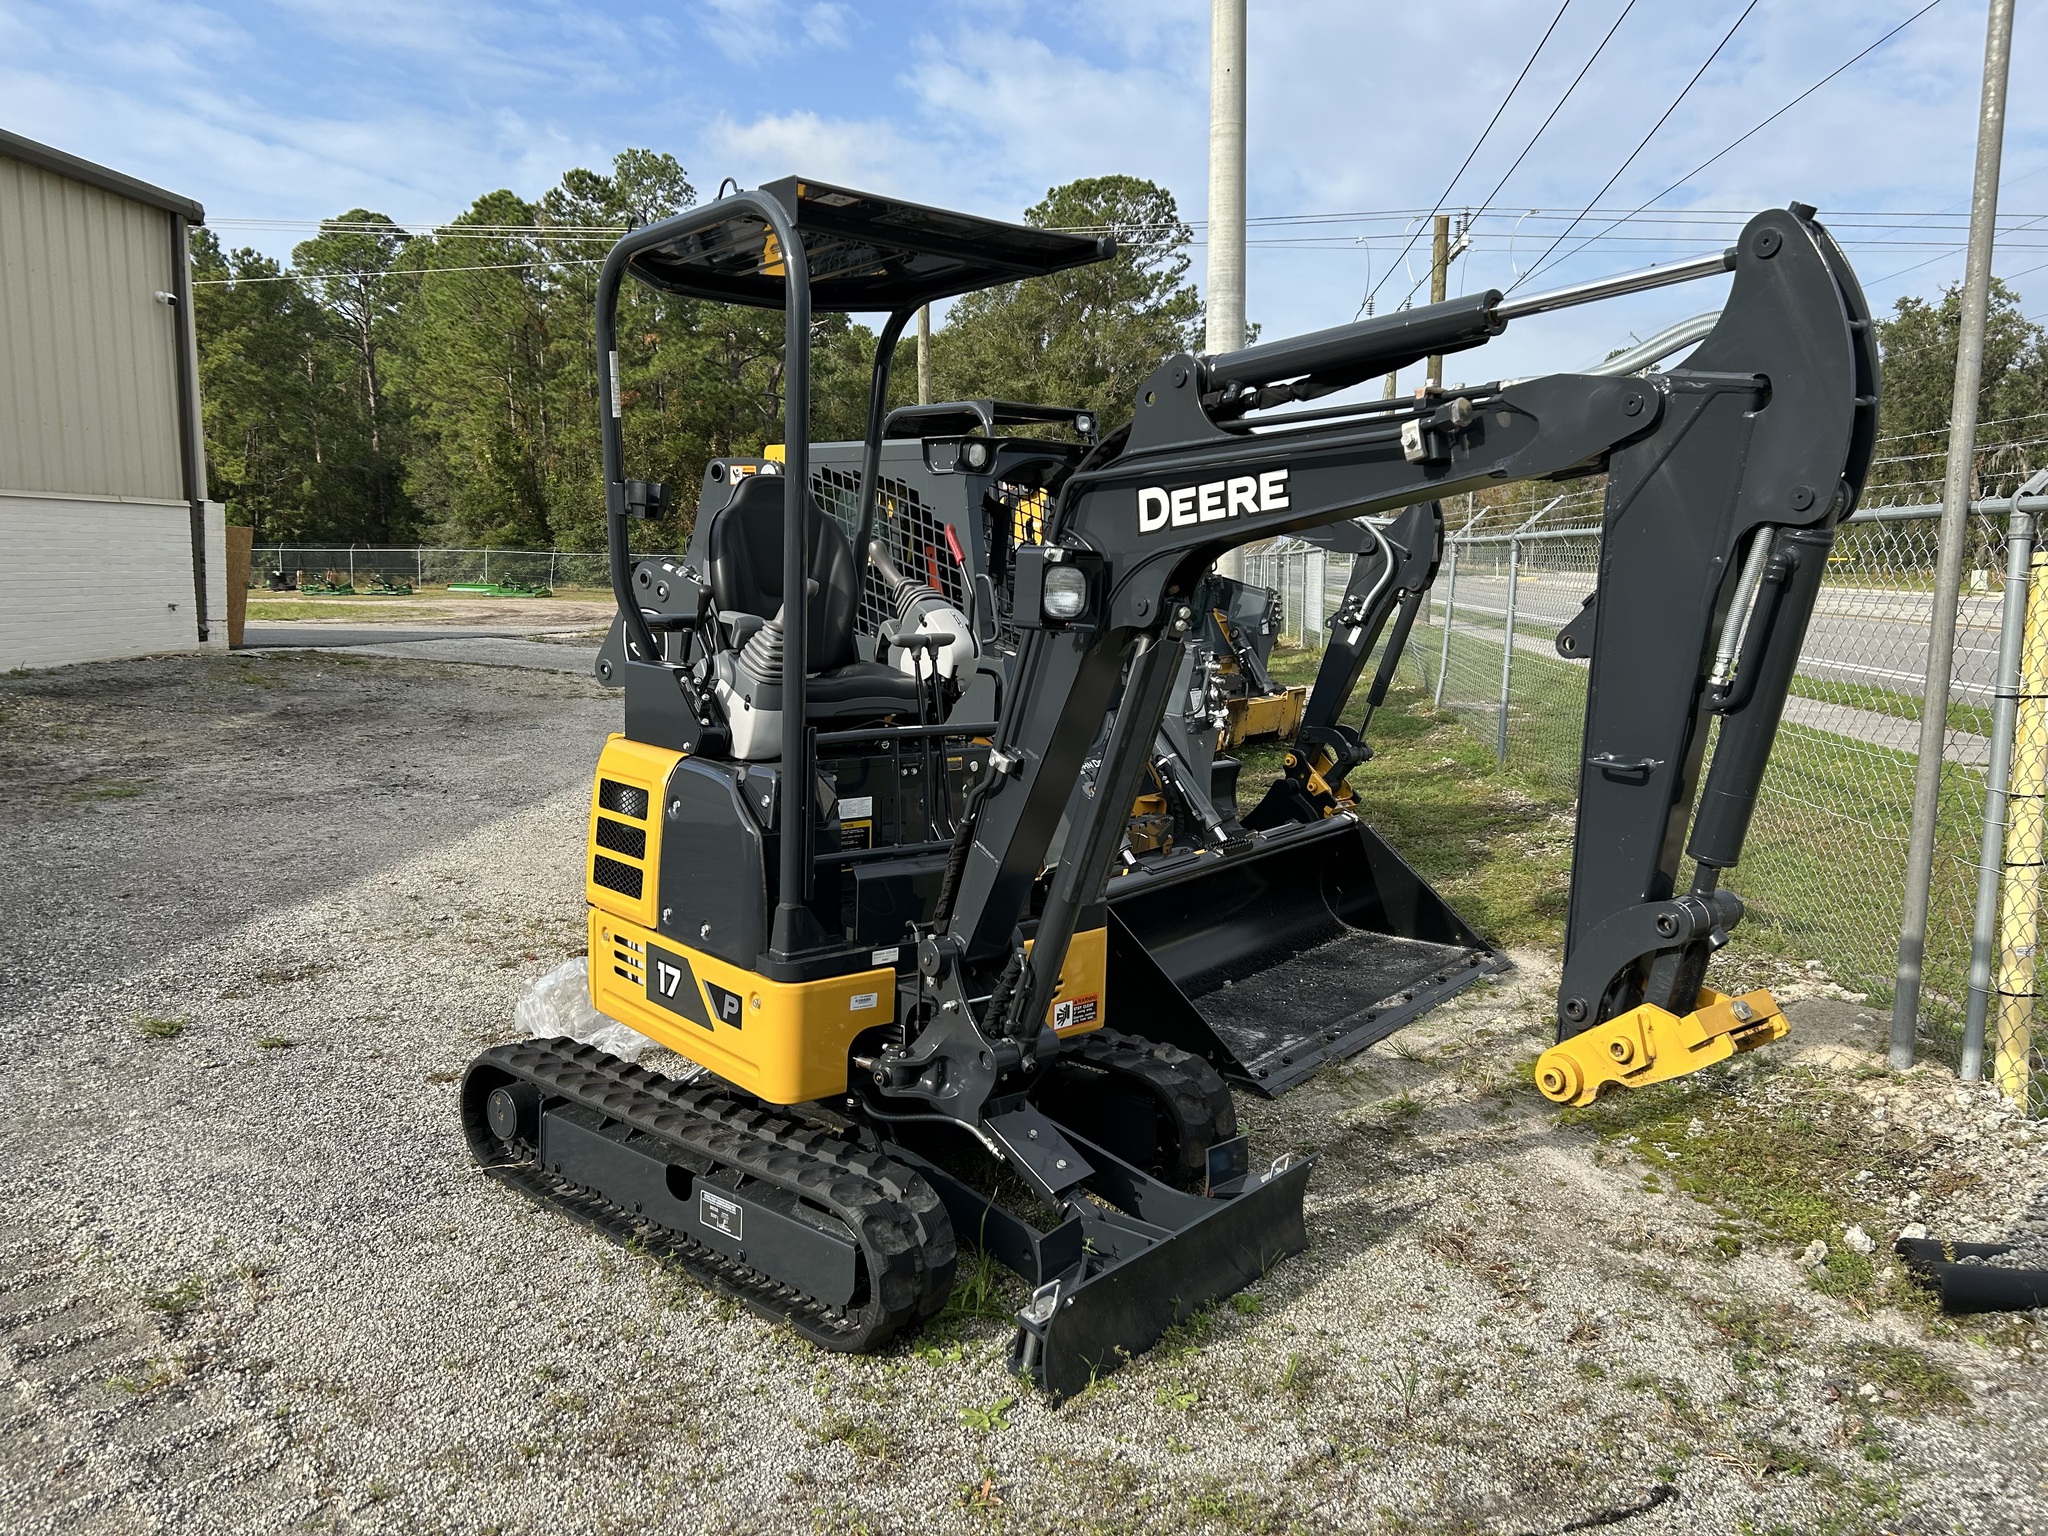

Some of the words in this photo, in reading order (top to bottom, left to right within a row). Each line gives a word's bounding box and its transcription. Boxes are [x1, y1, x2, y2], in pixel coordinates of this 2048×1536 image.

[1138, 468, 1290, 533] DEERE
[657, 959, 681, 999] 17
[722, 993, 739, 1020] P
